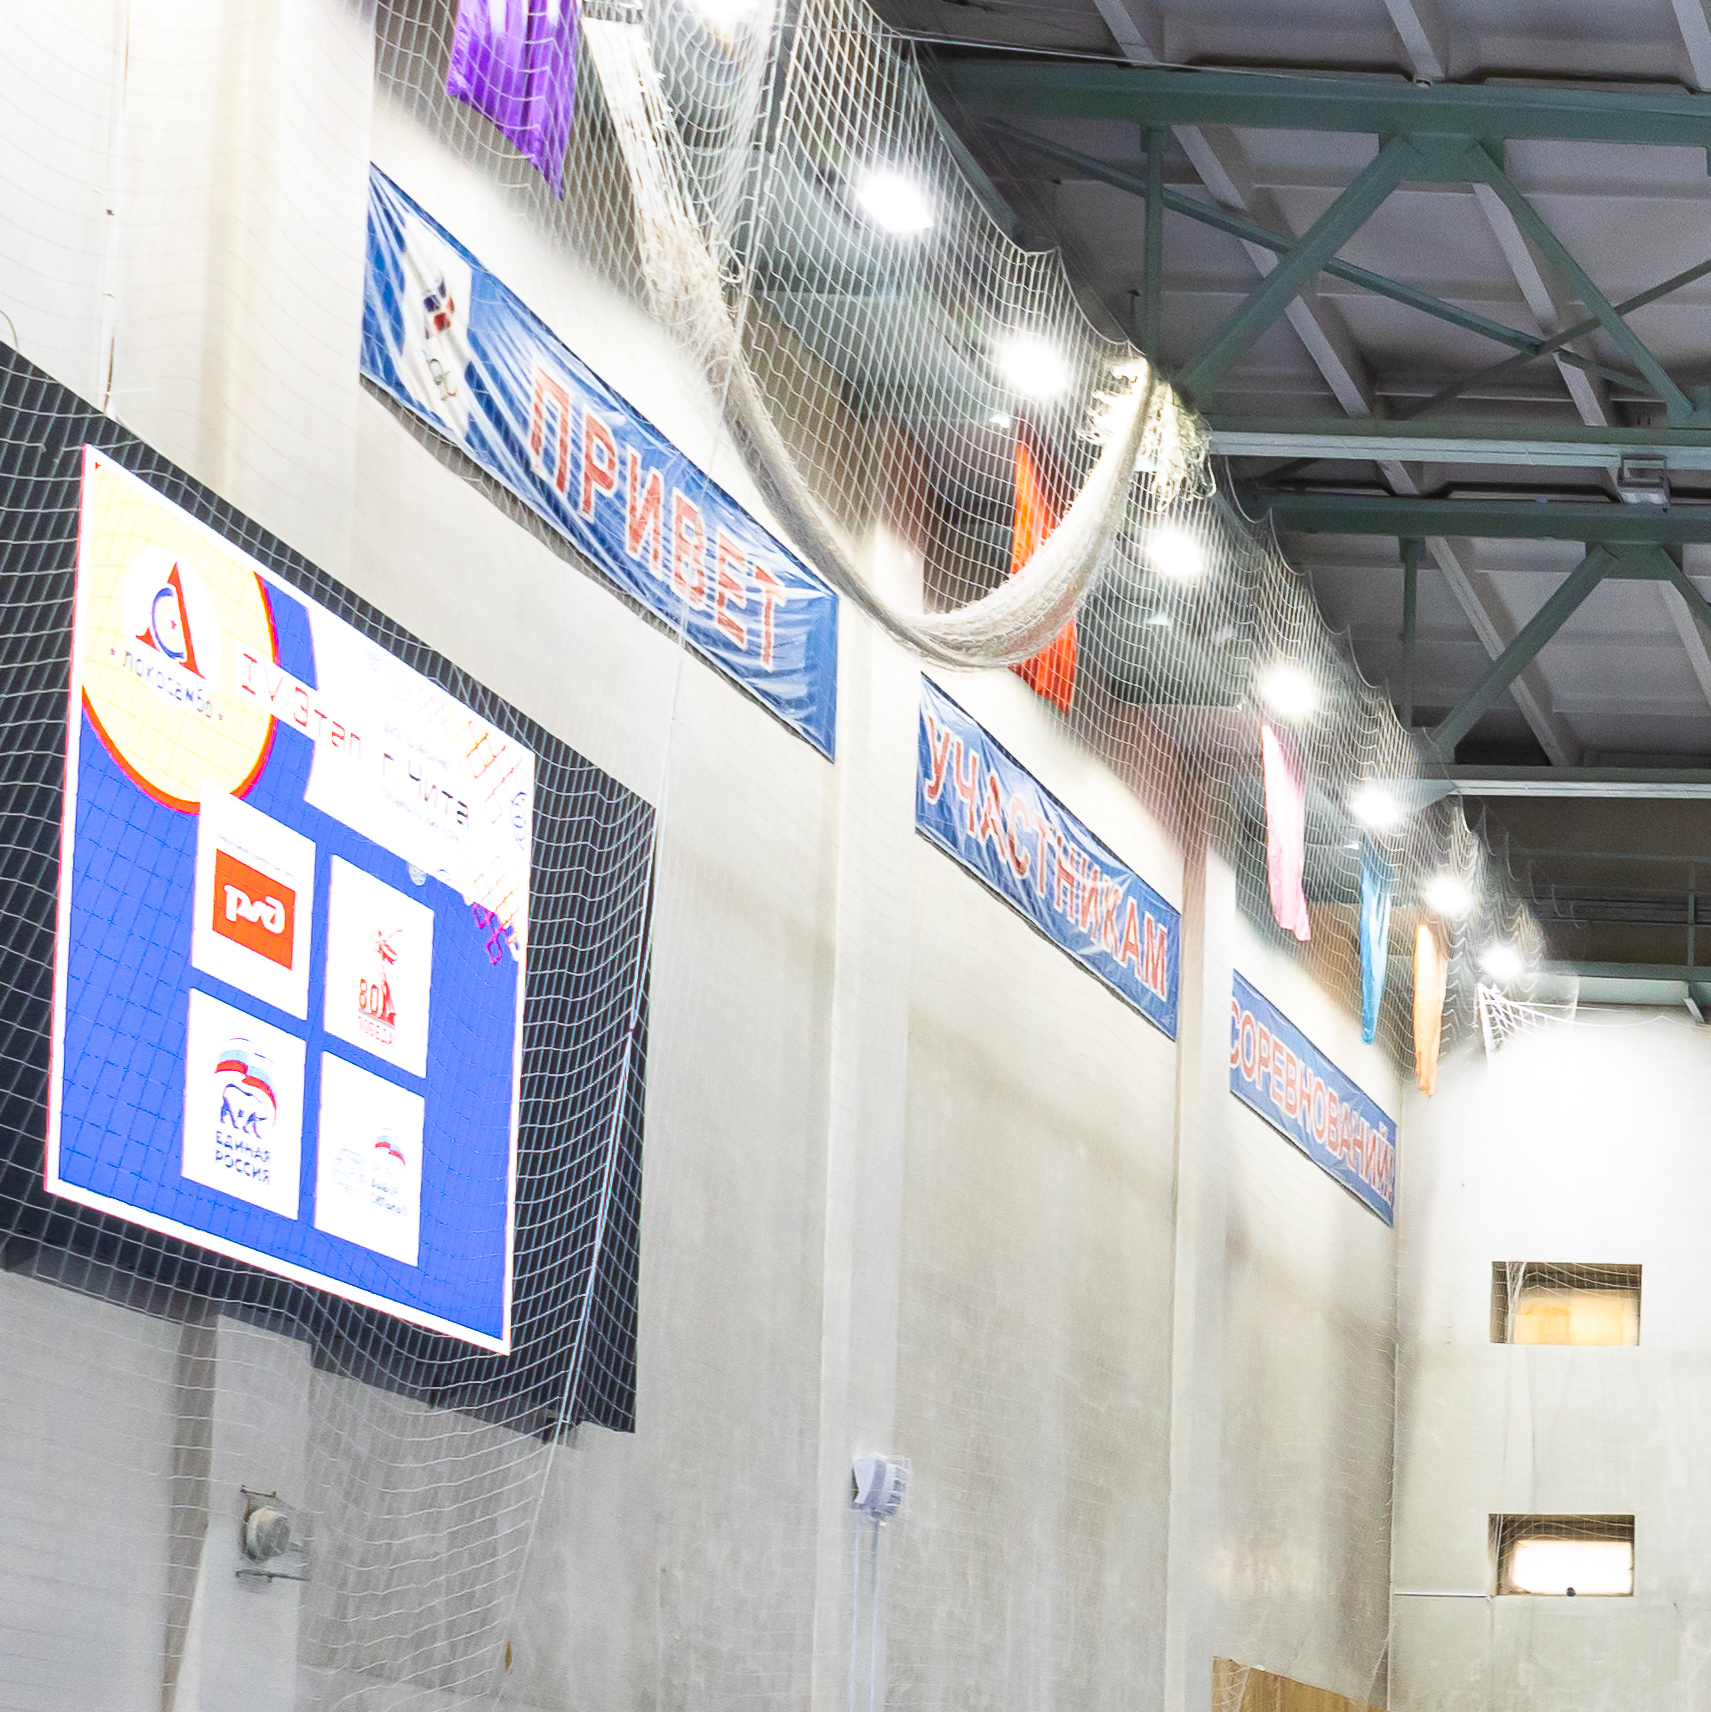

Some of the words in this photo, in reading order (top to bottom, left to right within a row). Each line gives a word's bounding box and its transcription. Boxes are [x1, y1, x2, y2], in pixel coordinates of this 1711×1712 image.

[530, 363, 785, 671] ПРИВЕТ
[924, 711, 1168, 1003] УЧАСТНИКАМ
[214, 1148, 271, 1185] РОССИЯ
[215, 1130, 271, 1164] ЕДИНАЯ
